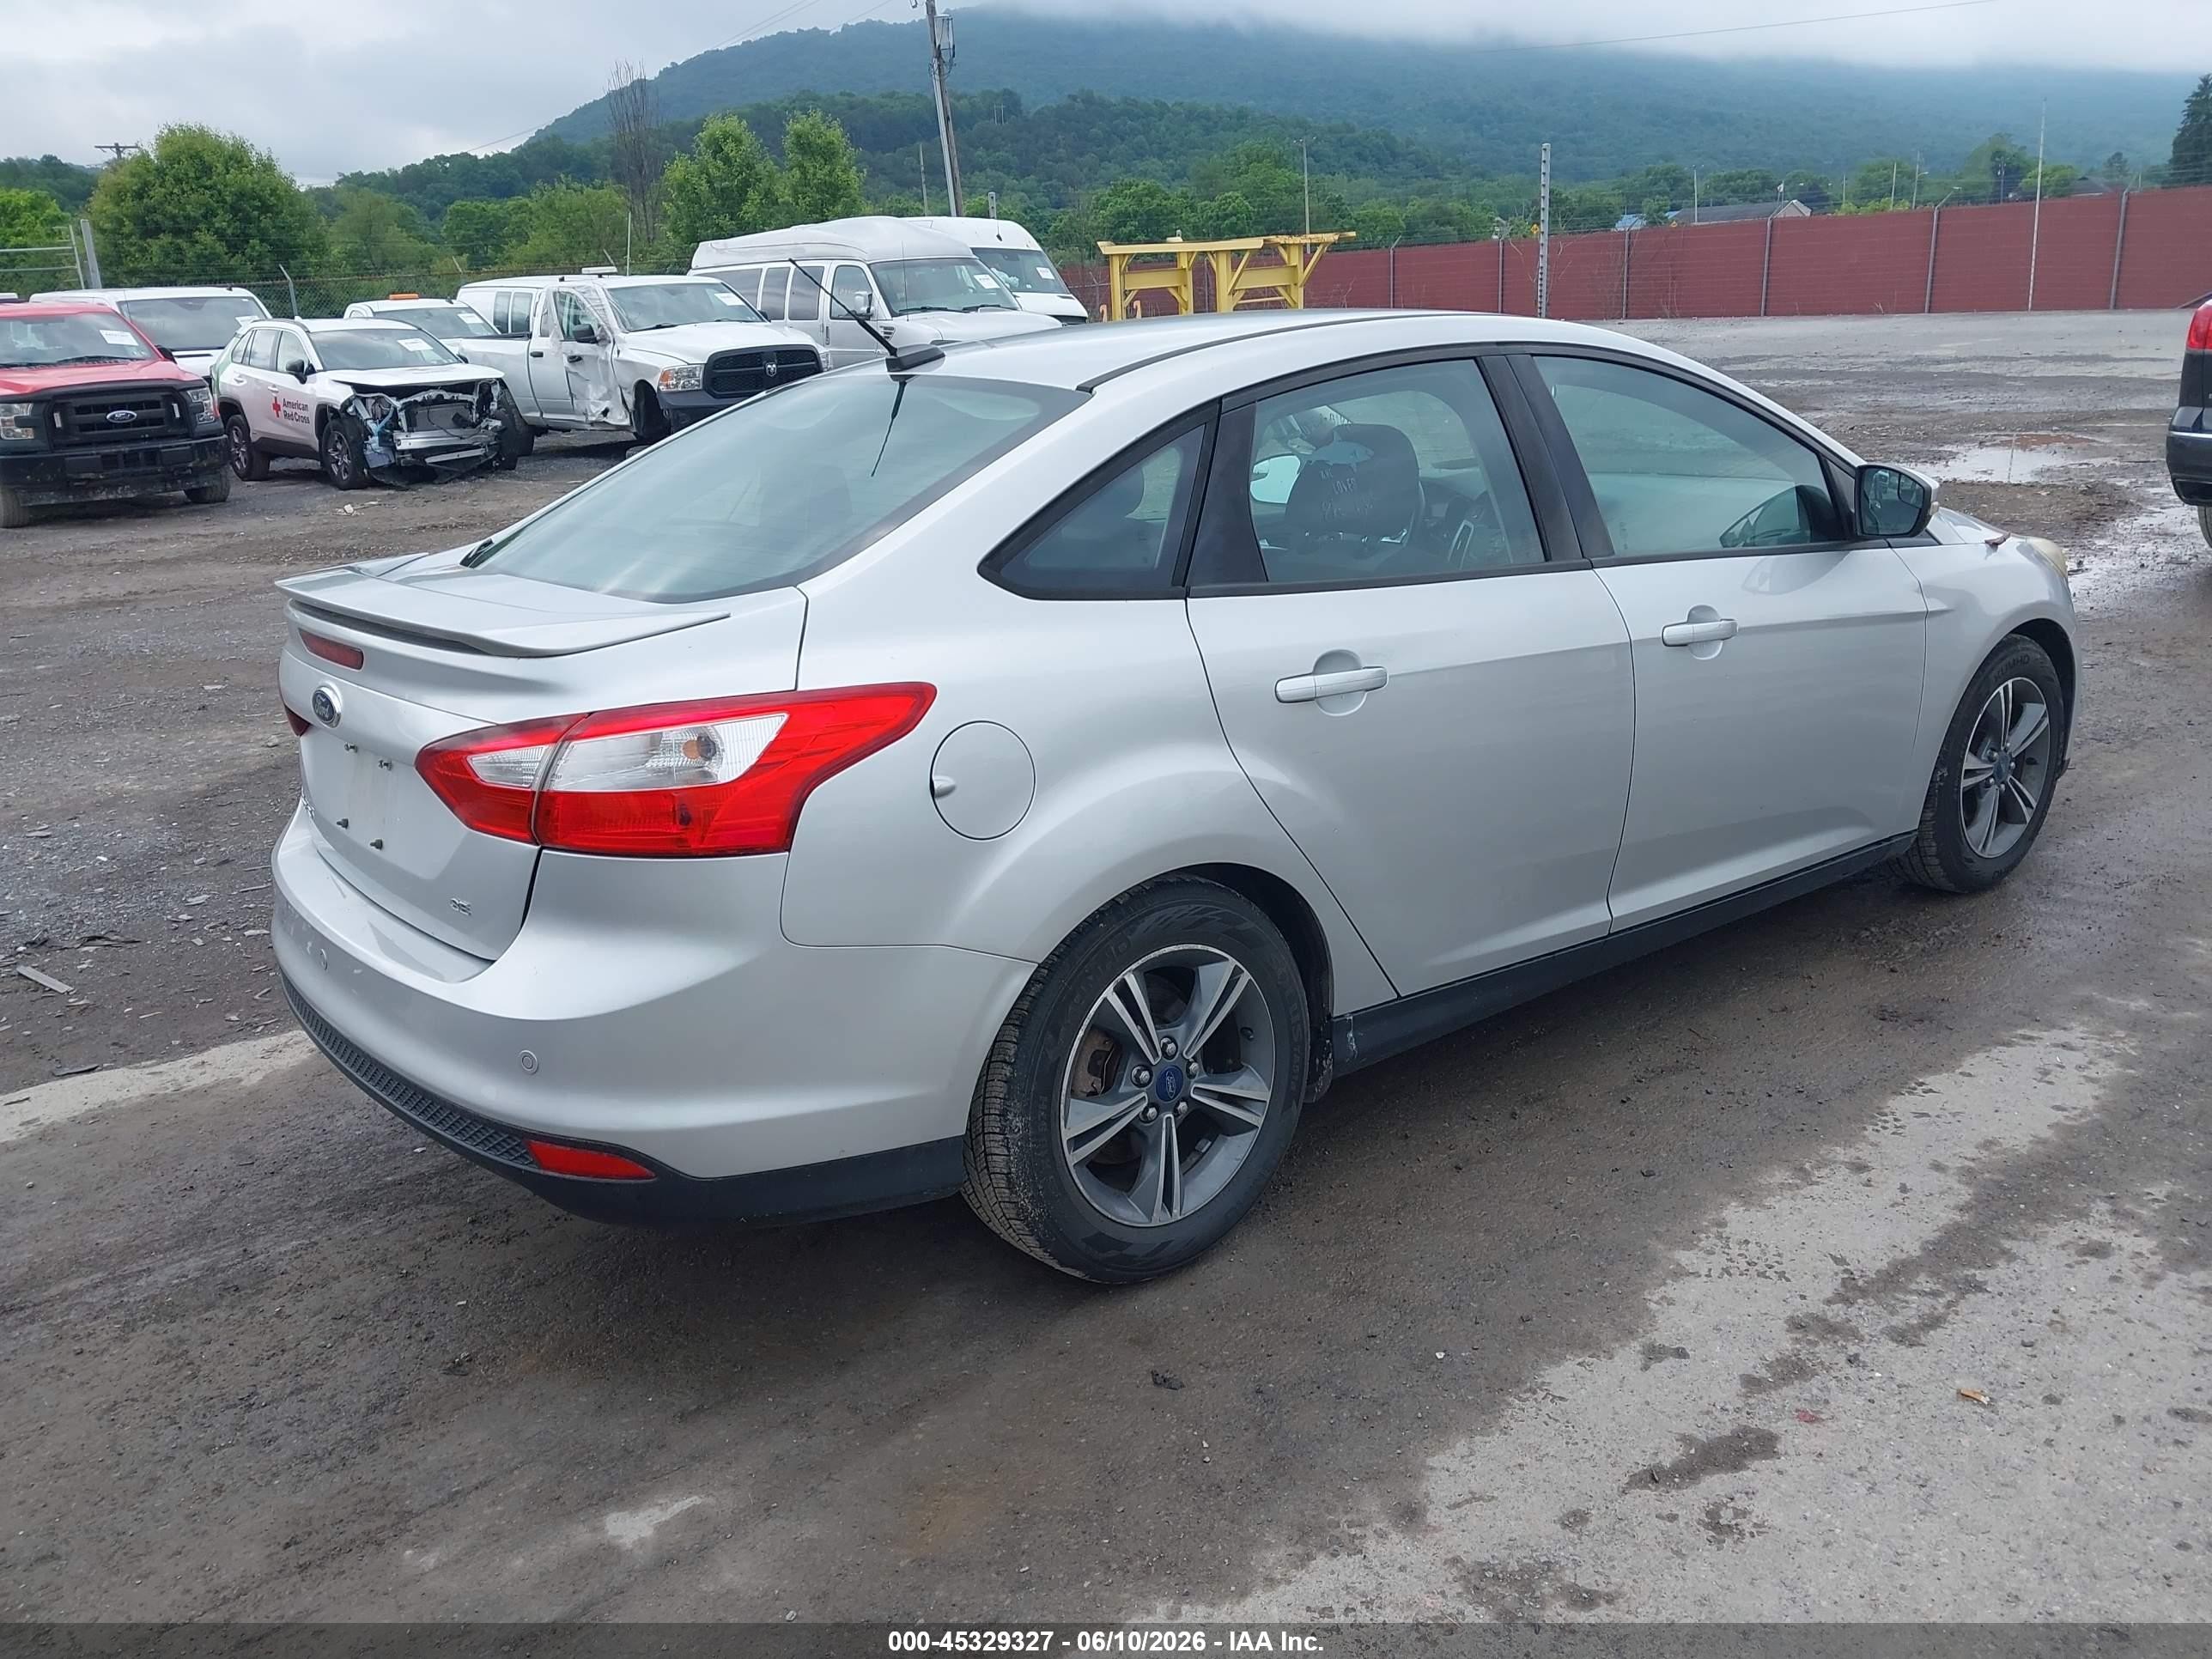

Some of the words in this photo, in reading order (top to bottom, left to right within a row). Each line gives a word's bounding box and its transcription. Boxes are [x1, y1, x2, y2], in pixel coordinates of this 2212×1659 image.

[283, 398, 309, 412] American
[283, 410, 295, 421] Red
[294, 411, 310, 424] Cross
